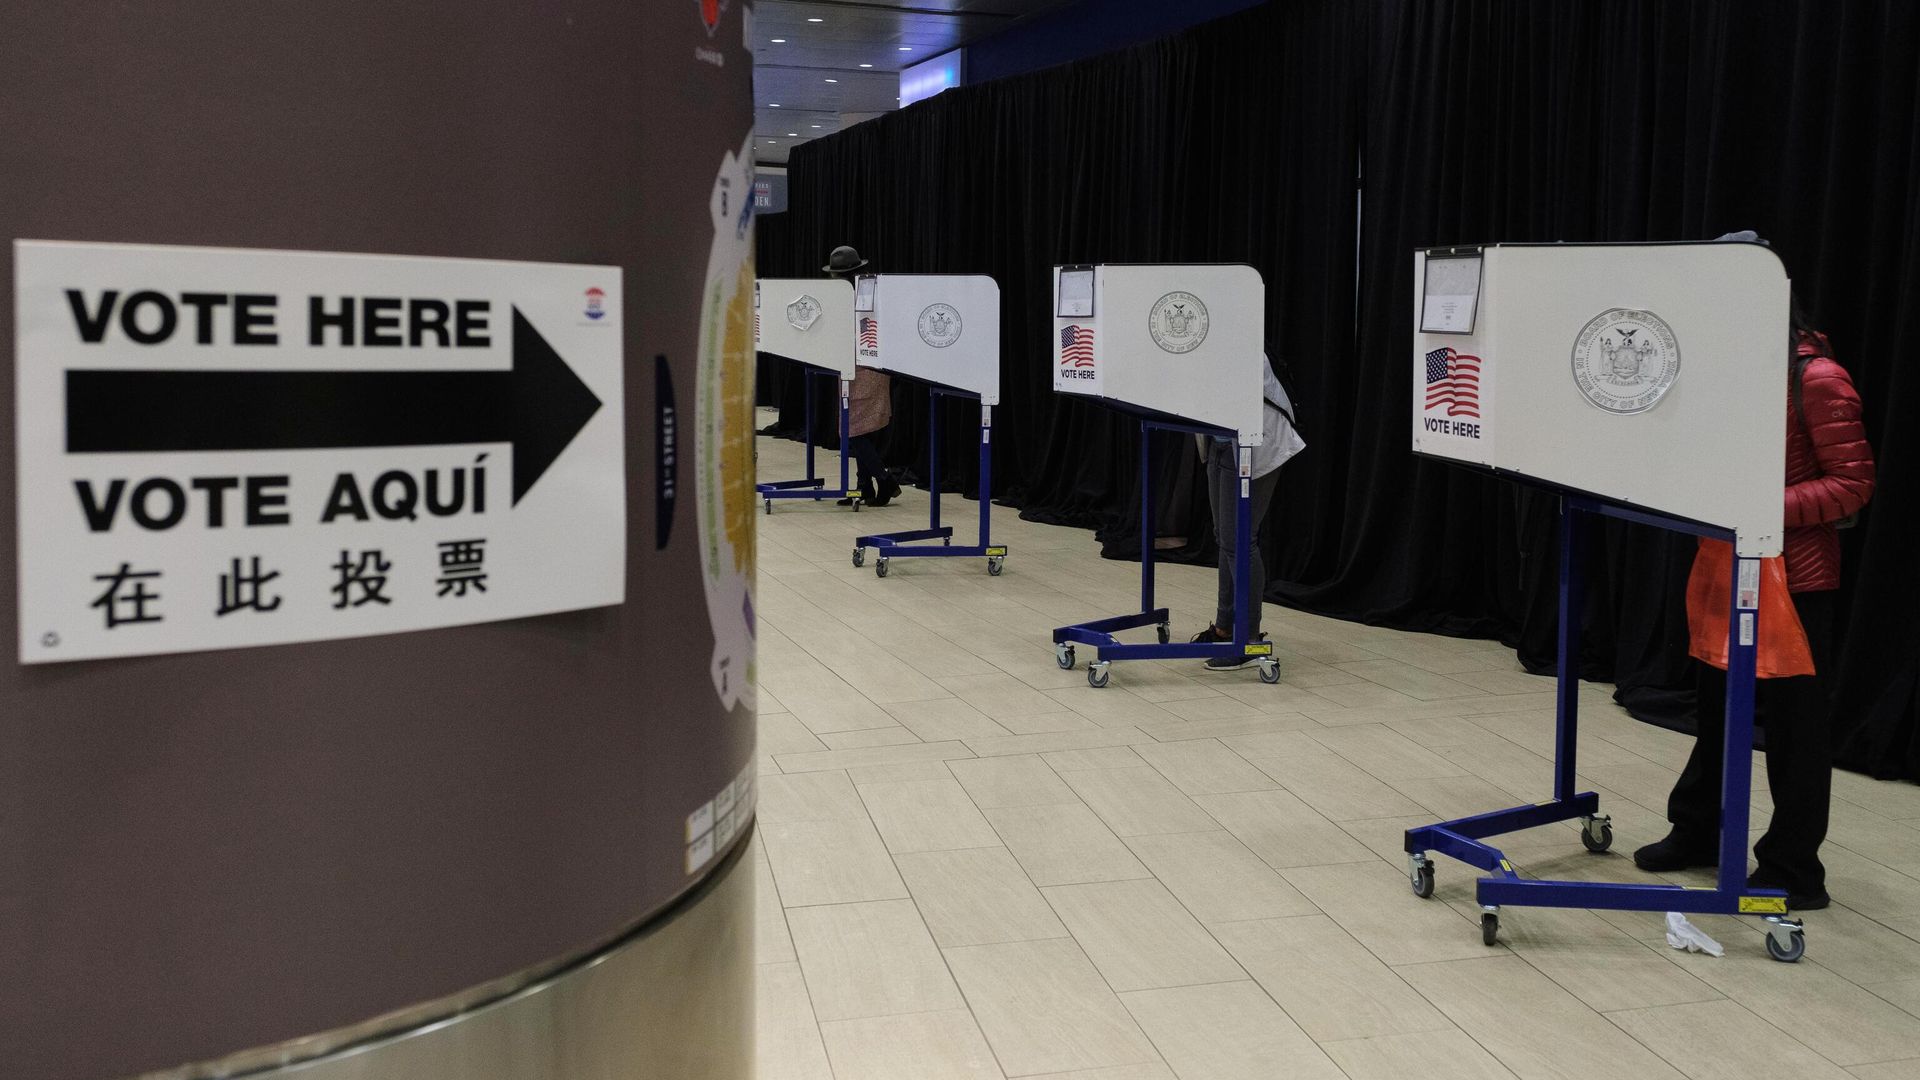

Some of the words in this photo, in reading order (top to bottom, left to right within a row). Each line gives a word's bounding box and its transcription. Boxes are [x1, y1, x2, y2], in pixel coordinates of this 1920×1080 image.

[65, 289, 279, 346] VOTE
[308, 295, 492, 348] HERE
[1061, 369, 1077, 379] VOTE
[1078, 370, 1095, 380] HERE
[1424, 418, 1450, 435] VOTE
[1452, 420, 1480, 439] HERE
[74, 476, 291, 532] VOTE
[320, 453, 489, 523] AQUÍ
[90, 538, 489, 630] 在此投票
